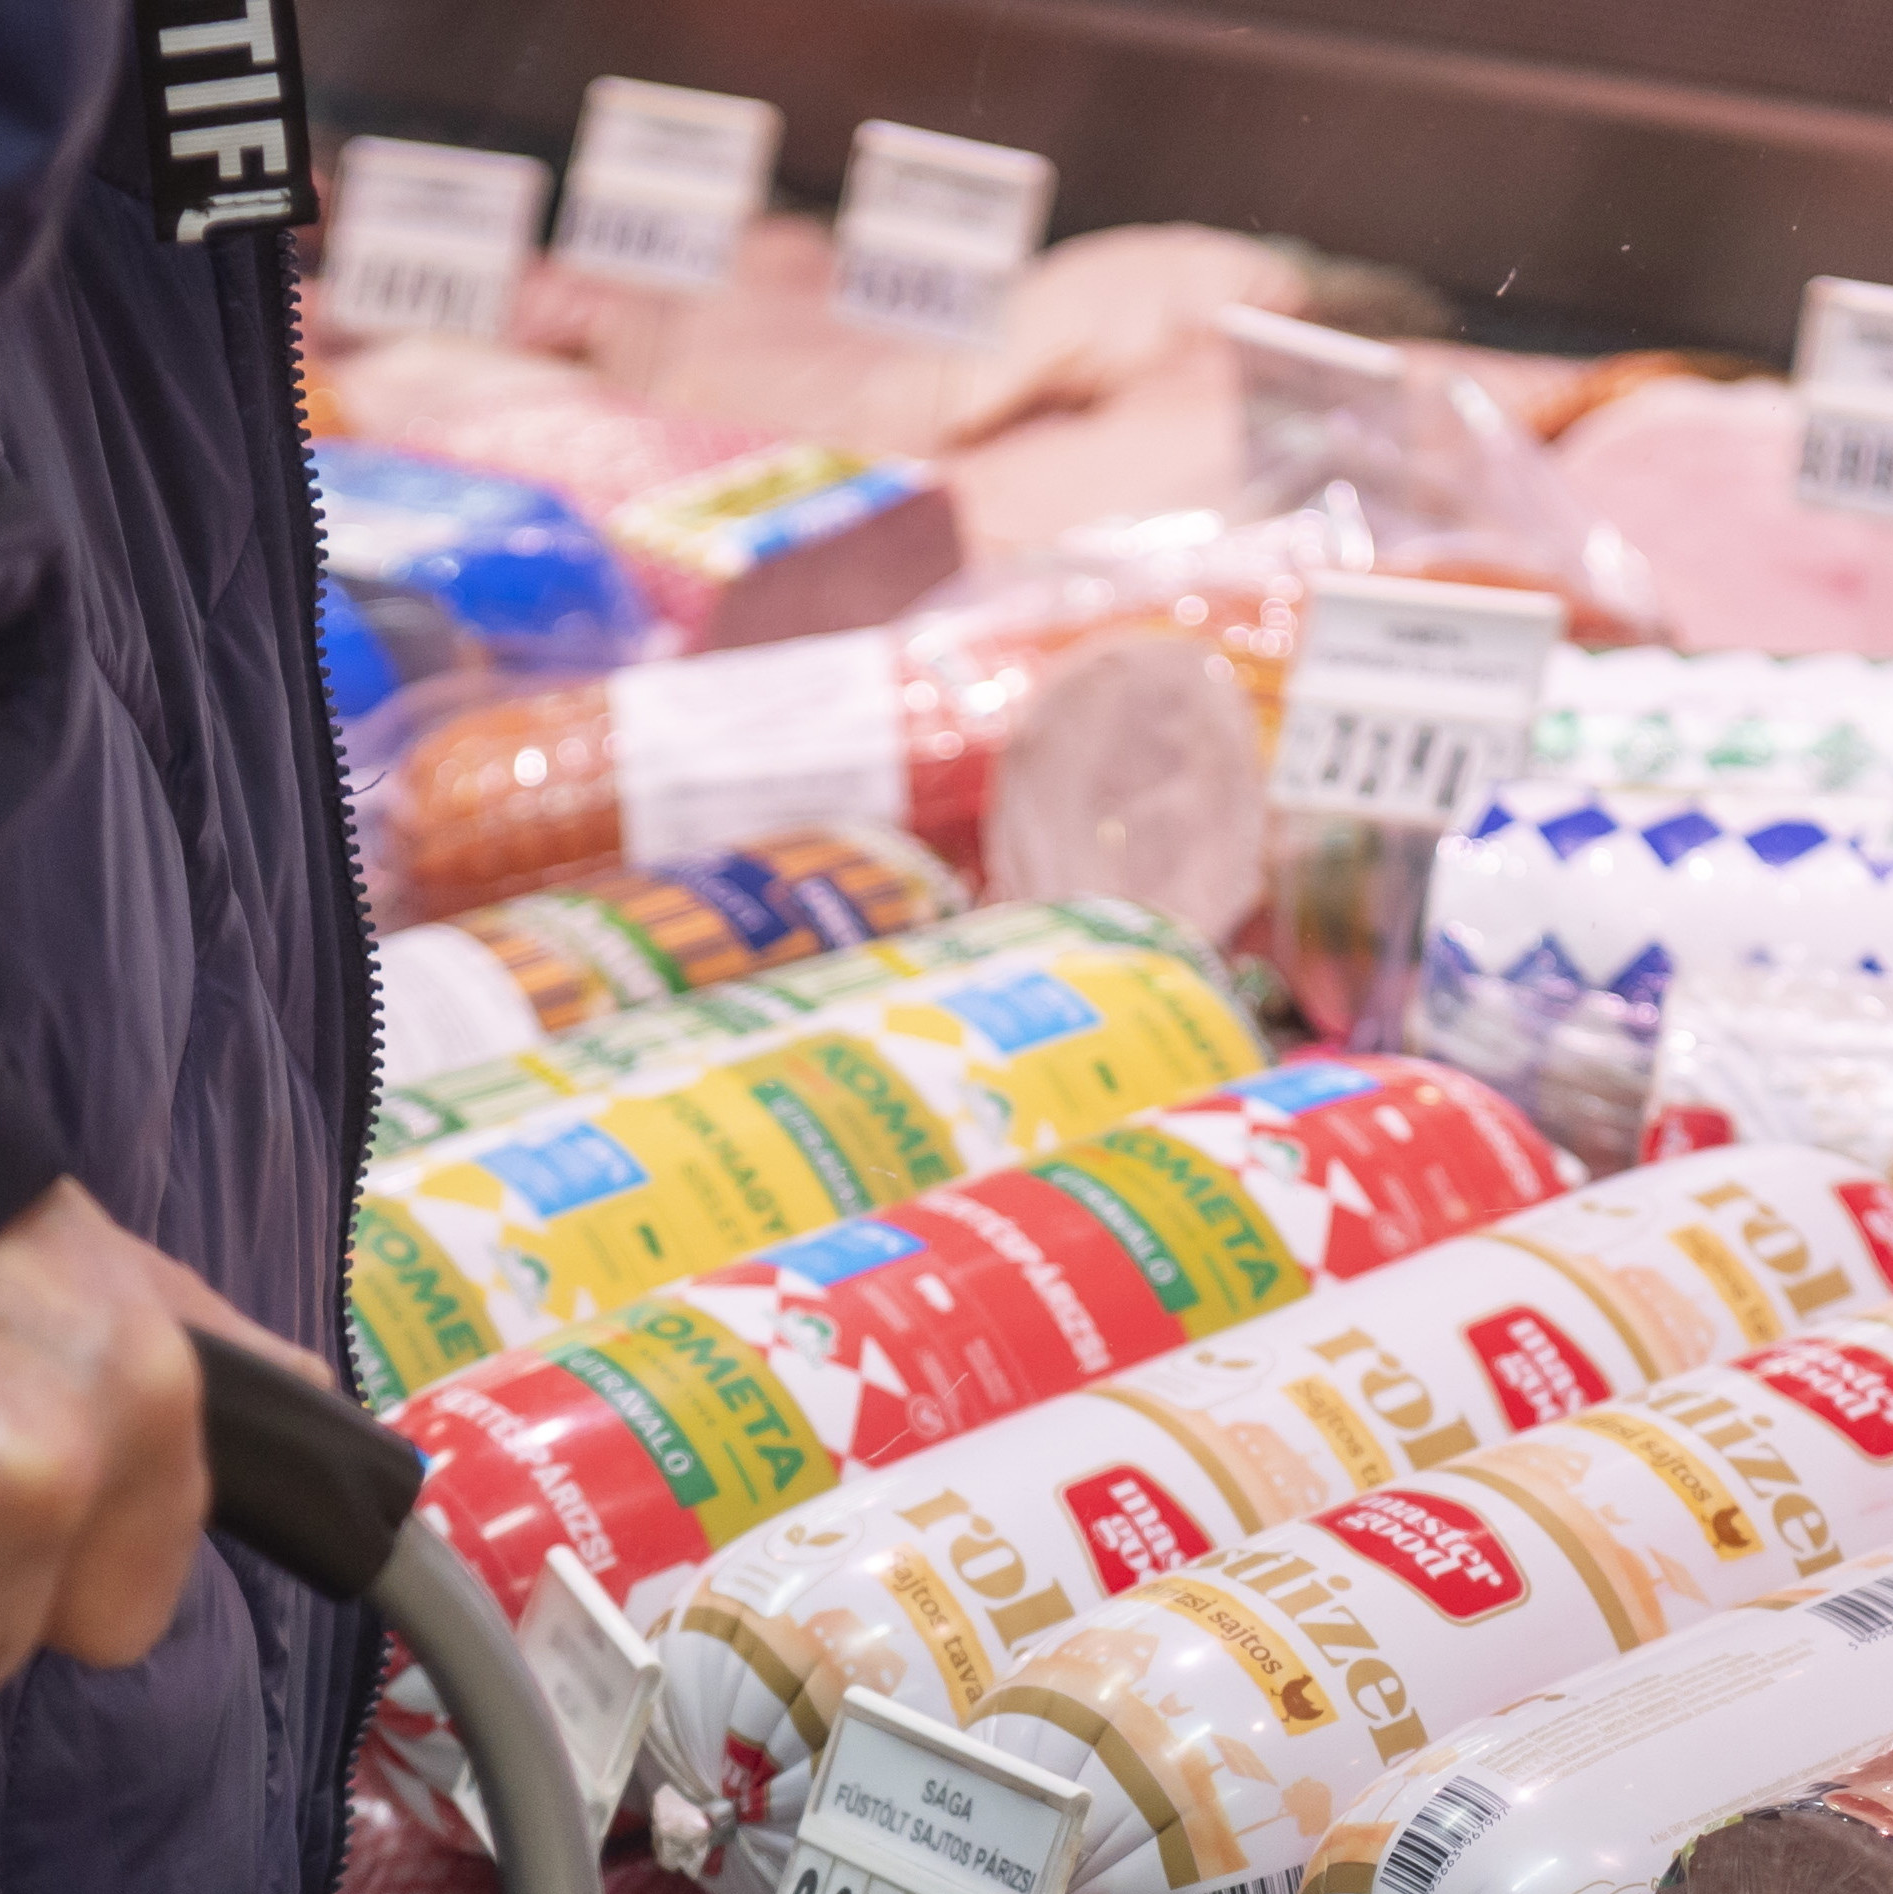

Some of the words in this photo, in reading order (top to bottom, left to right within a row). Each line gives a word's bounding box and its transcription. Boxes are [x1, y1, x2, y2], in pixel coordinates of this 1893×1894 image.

[1691, 1180, 1855, 1319] rol
[1307, 1327, 1481, 1470] rol
[1508, 1315, 1589, 1420] mas
[894, 1487, 1078, 1652] rol
[1109, 1479, 1191, 1576] mas
[1336, 1506, 1456, 1586] good
[1356, 1492, 1503, 1590] master
[1208, 1606, 1284, 1678] sajtos
[920, 1776, 974, 1824] SÁGA
[909, 1817, 972, 1868] SAJTOS
[973, 1848, 1036, 1894] PÁRIZSI
